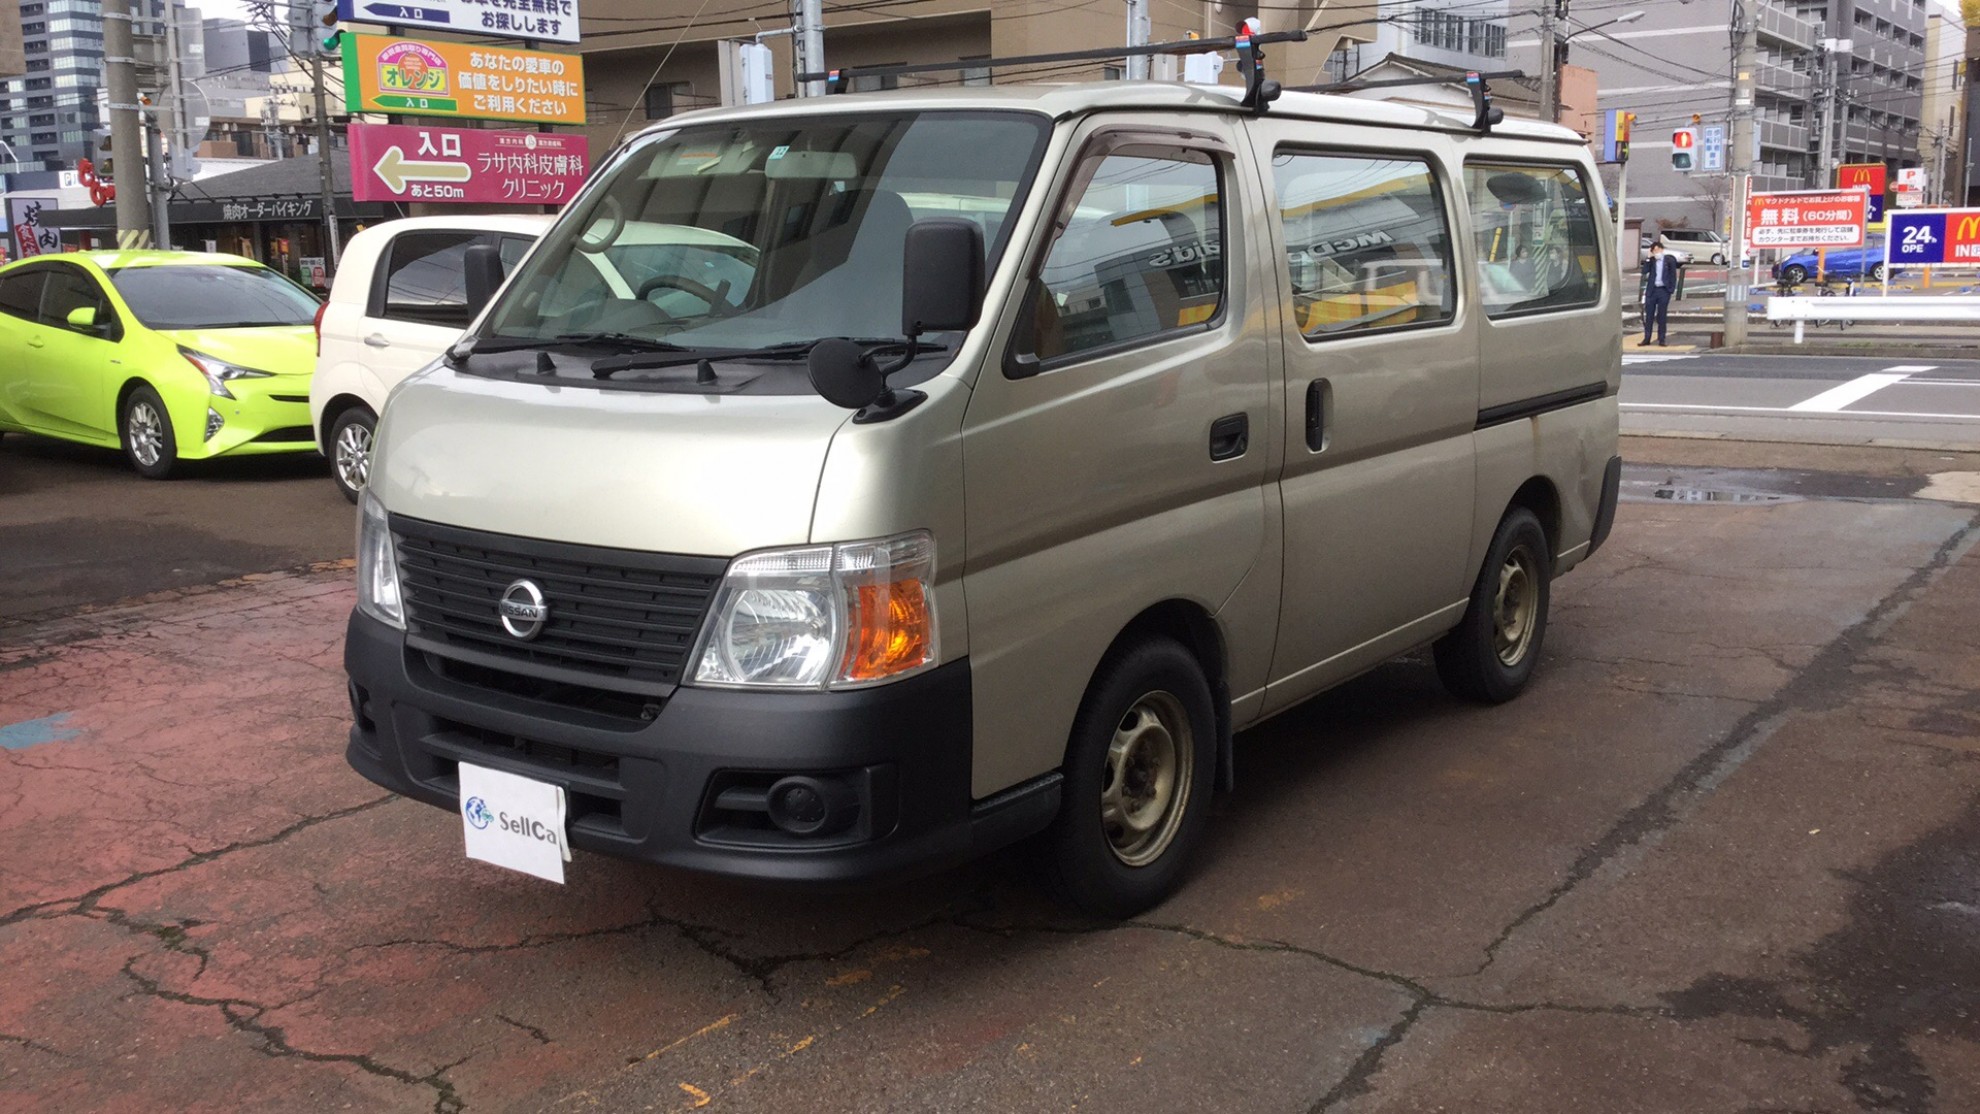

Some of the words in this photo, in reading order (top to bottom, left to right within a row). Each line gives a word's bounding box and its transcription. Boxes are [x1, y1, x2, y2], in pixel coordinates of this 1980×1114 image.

[400, 7, 423, 19] 入口
[481, 11, 562, 35] お探しします
[470, 52, 564, 75] あなたの愛車の
[386, 68, 441, 88] オレンジ
[458, 71, 579, 97] 価値をしりたい時に
[406, 97, 428, 108] 入口
[473, 95, 567, 115] ご利用ください
[418, 132, 461, 157] 入口
[477, 152, 584, 176] ラサ内科皮膚科
[411, 184, 464, 198] あと50m
[502, 178, 565, 199] クリニック
[223, 200, 313, 220] 焼肉オーダーバイキング
[1761, 208, 1799, 225] 無料
